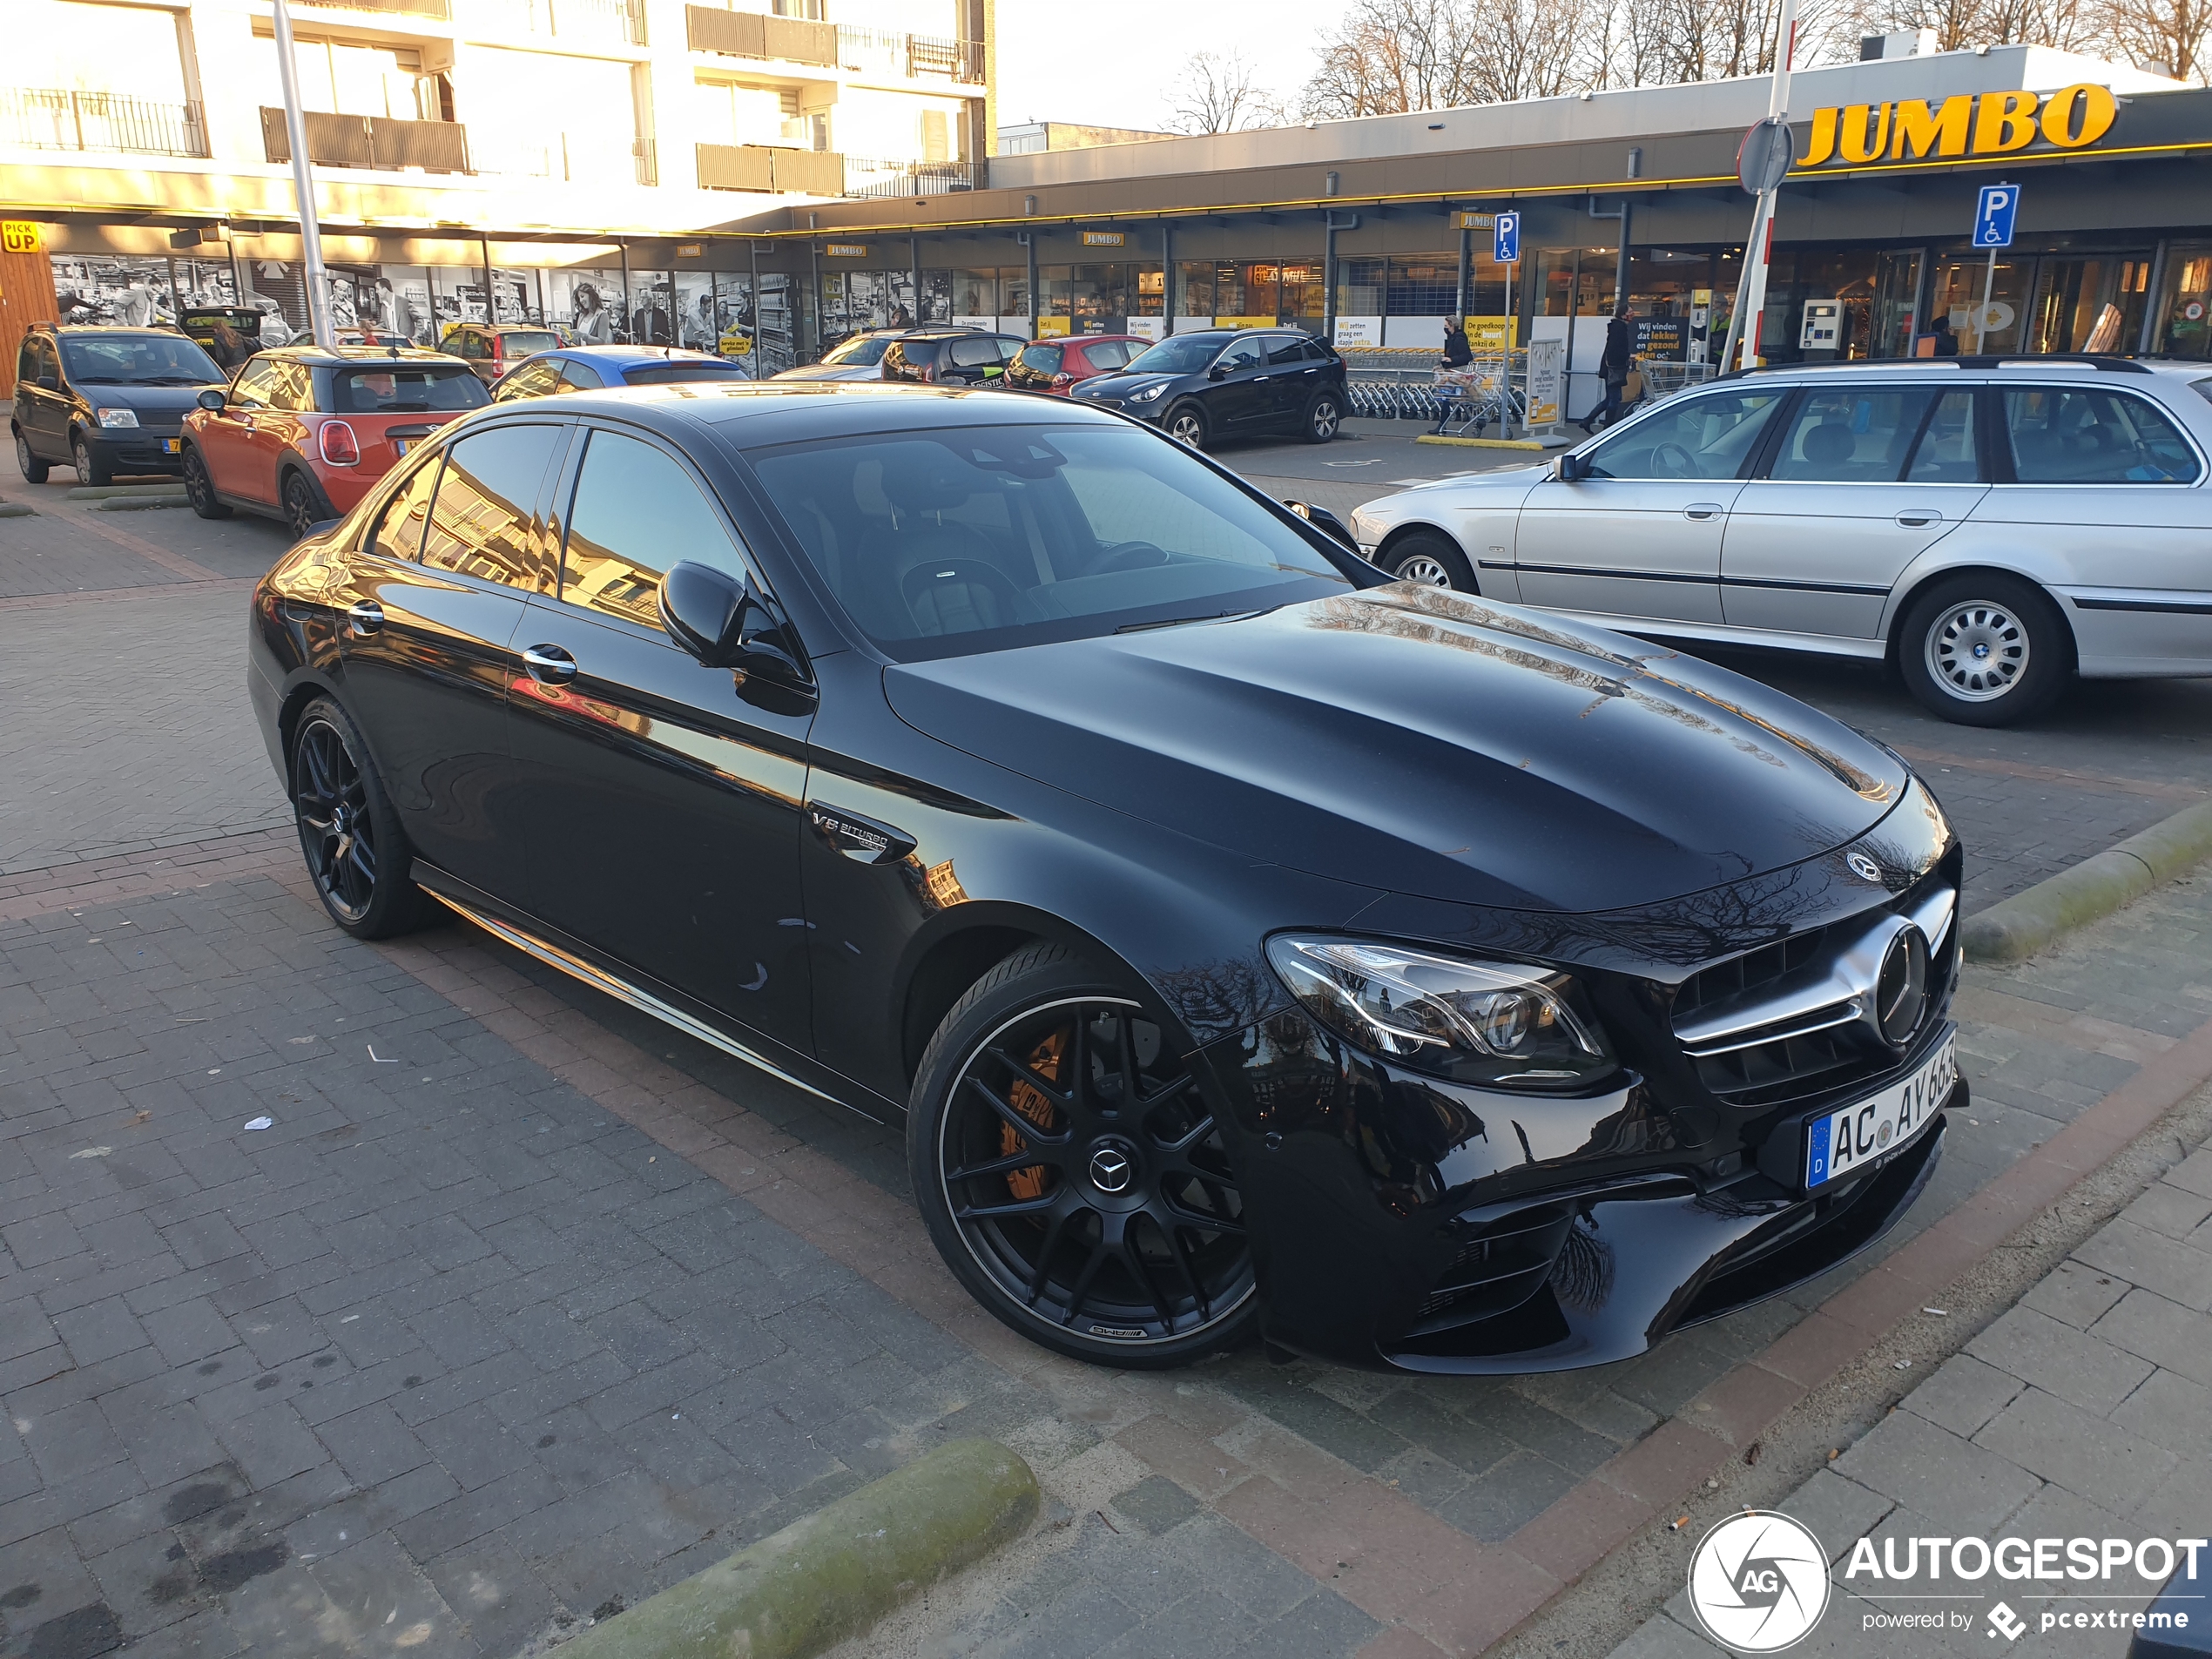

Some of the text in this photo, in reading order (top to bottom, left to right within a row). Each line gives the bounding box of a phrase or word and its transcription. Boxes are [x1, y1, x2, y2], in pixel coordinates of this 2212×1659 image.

[1796, 83, 2117, 166] JUMBO
[1985, 191, 2009, 221] P
[5, 224, 32, 233] PICK
[1500, 217, 1514, 241] P
[7, 234, 35, 250] UP
[1087, 234, 1121, 245] JUMBO
[832, 246, 863, 255] JUMBO
[1339, 321, 1349, 331] Wij
[1638, 322, 1651, 332] Wij
[1482, 330, 1502, 339] buurt
[1651, 331, 1679, 340] lekker
[1647, 341, 1680, 351] gezond
[813, 812, 888, 846] V8 BITURBO
[1814, 1158, 1823, 1174] D
[1832, 1103, 1876, 1170] AC
[1896, 1069, 1927, 1137] AY
[1928, 1035, 1955, 1108] 663
